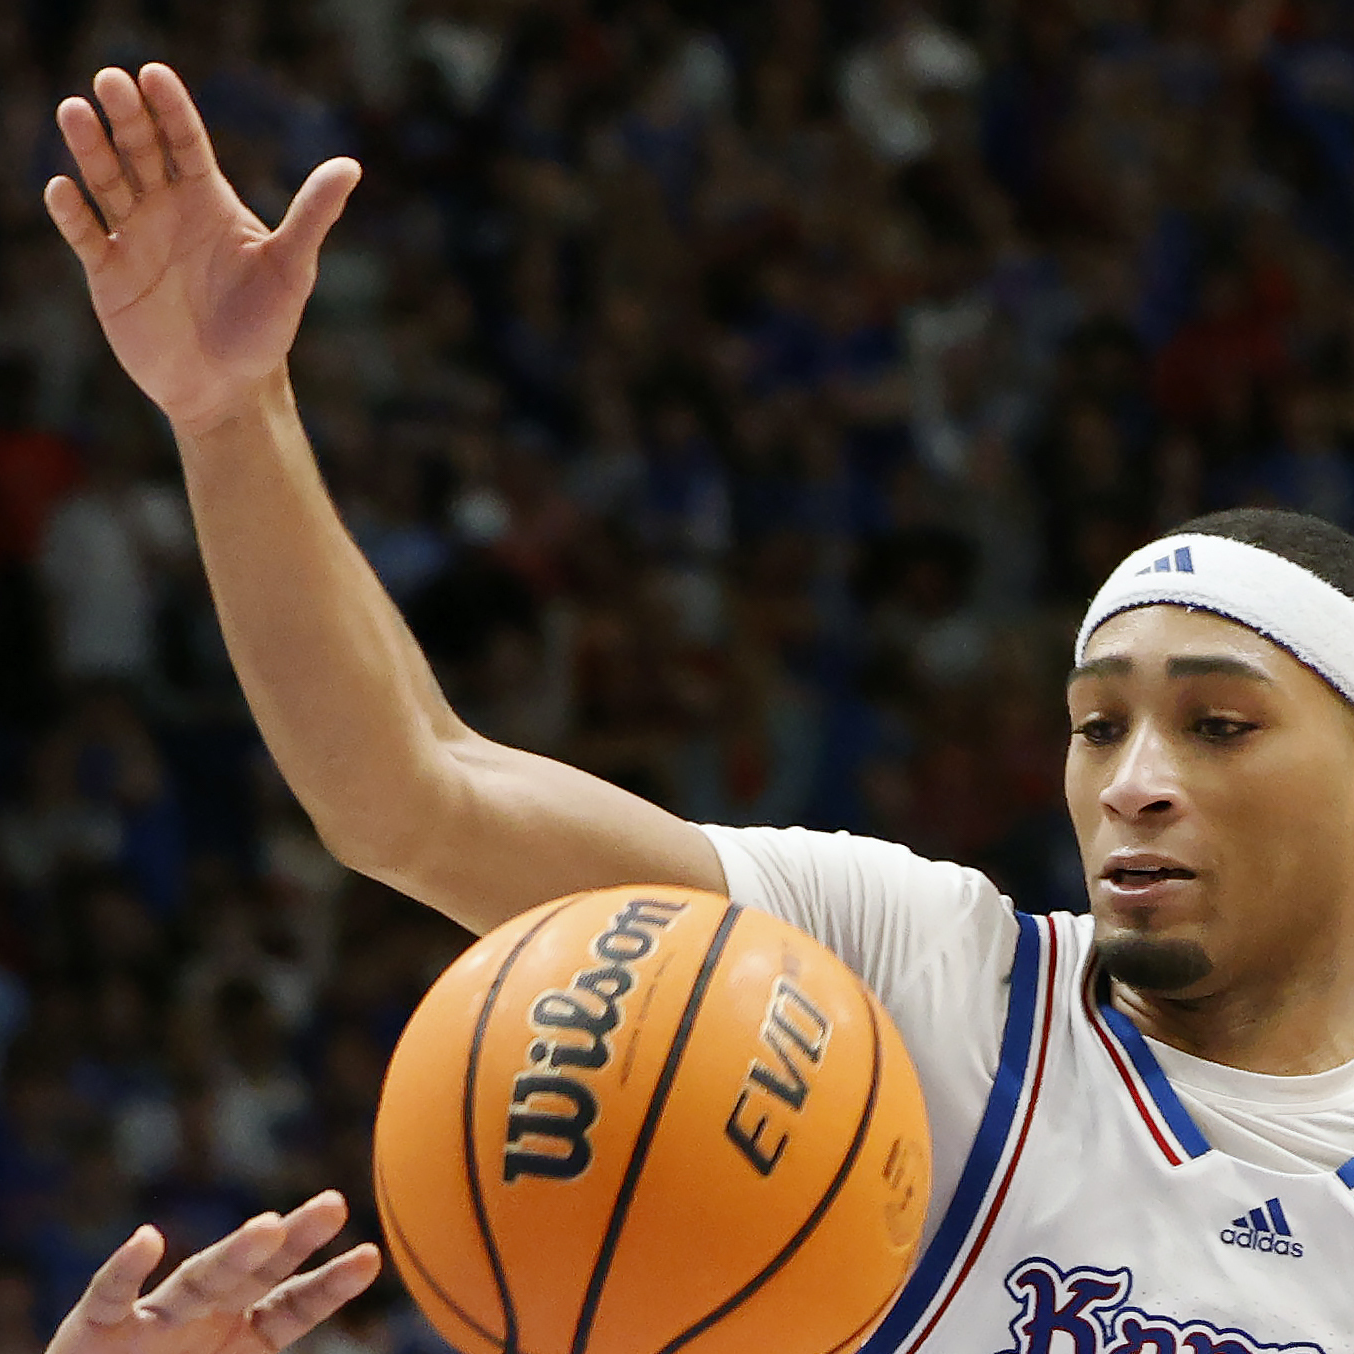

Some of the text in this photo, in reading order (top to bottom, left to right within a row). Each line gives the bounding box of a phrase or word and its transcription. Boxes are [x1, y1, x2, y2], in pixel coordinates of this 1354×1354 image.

[502, 897, 692, 1184] Wilson
[724, 976, 833, 1178] EVO
[1220, 1228, 1304, 1258] adidas
